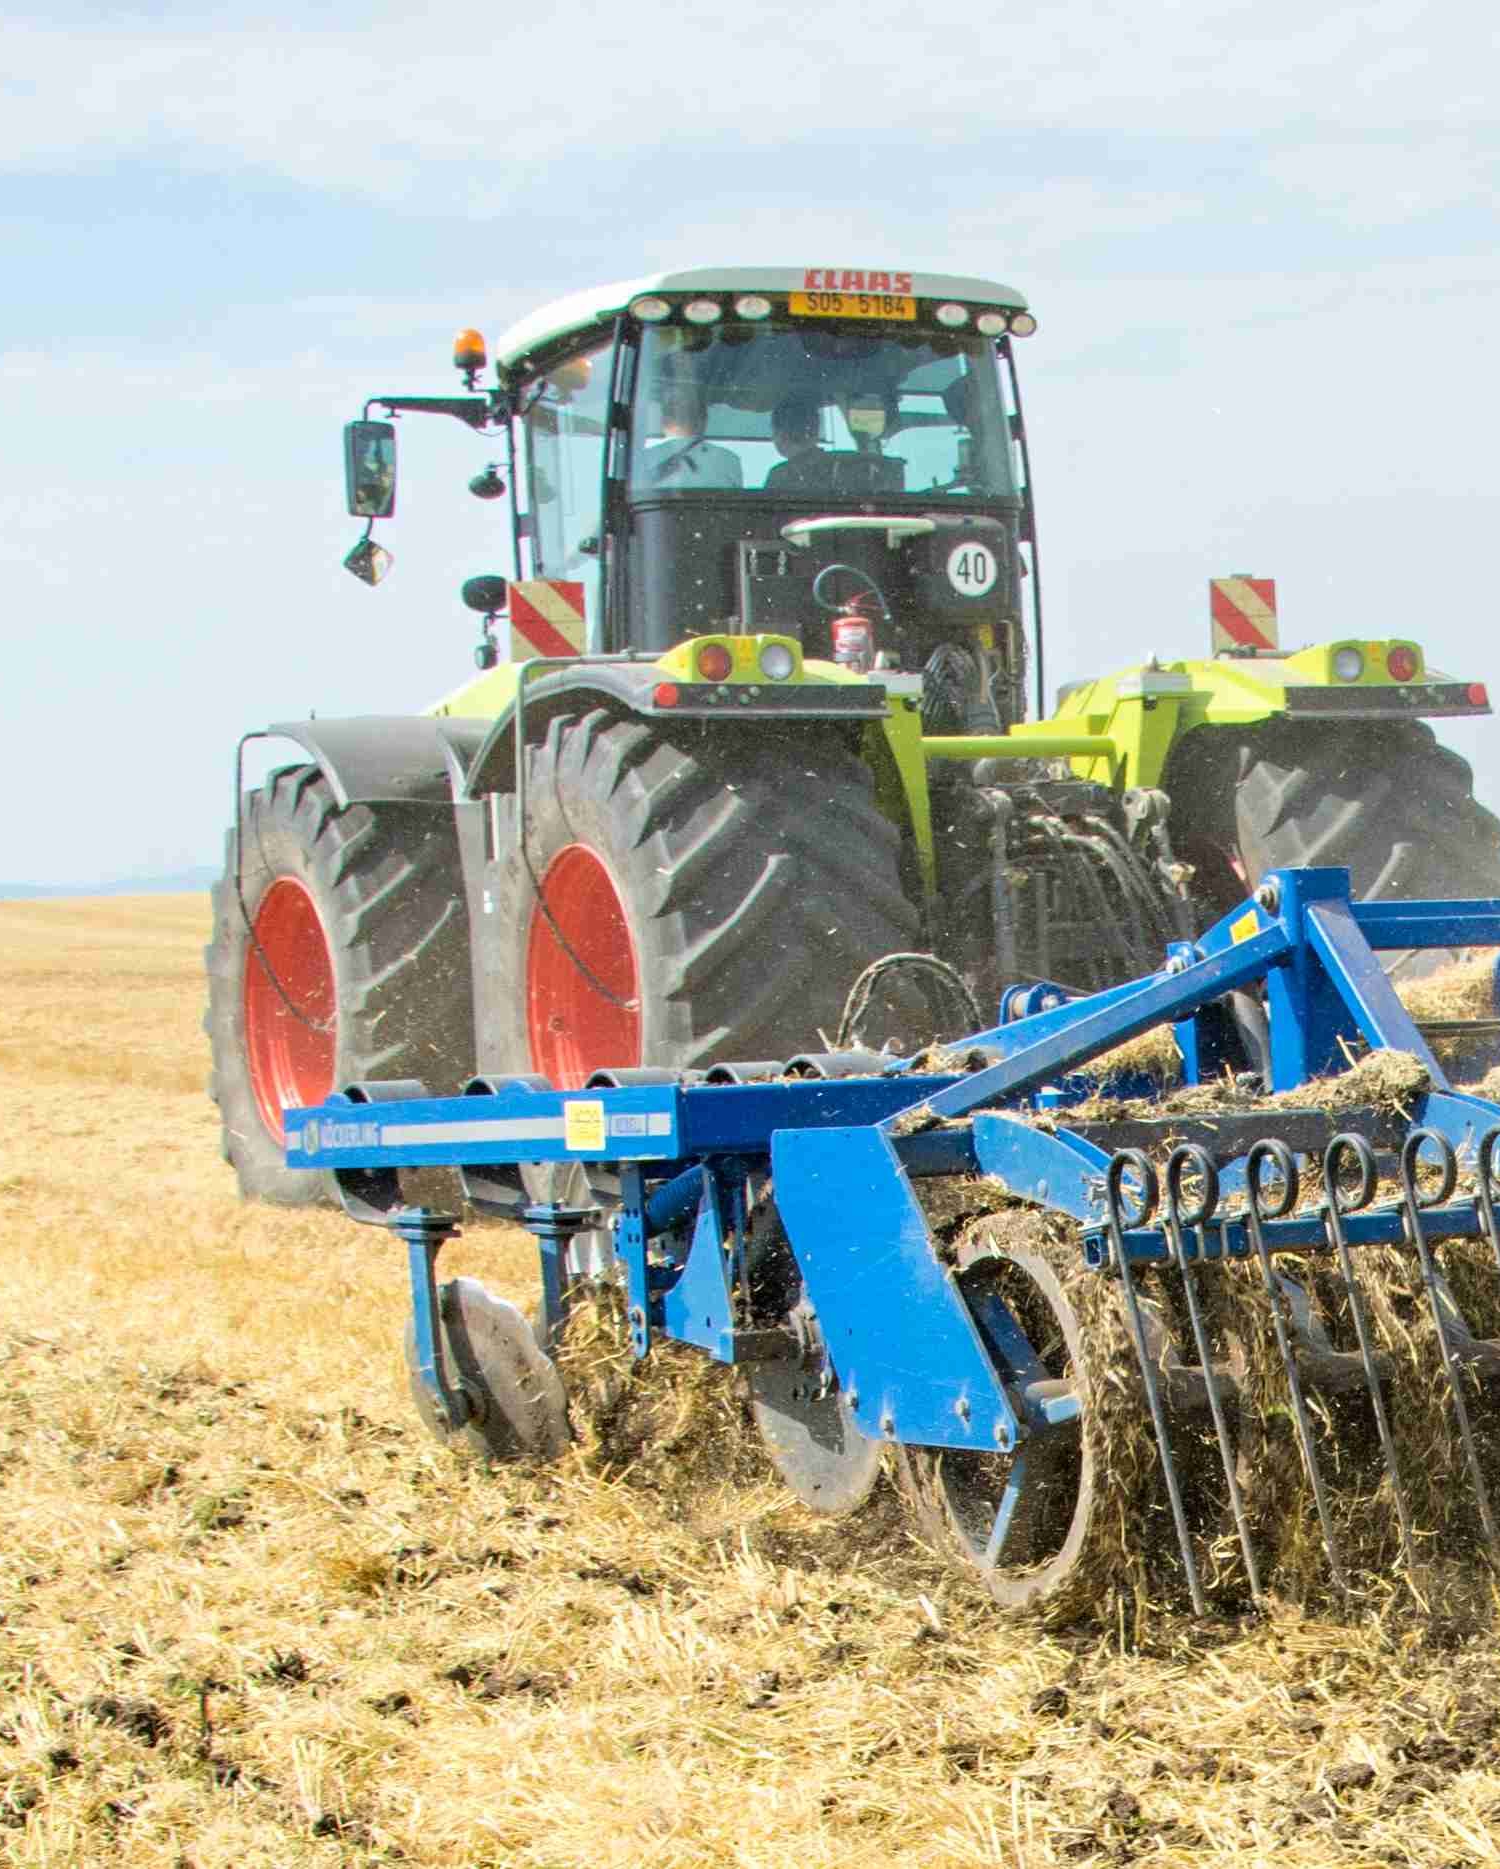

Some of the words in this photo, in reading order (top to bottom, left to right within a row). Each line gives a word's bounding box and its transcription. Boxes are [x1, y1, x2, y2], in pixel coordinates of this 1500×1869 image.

[804, 269, 912, 294] CLAAS
[858, 294, 906, 316] 5184
[957, 552, 987, 584] 40
